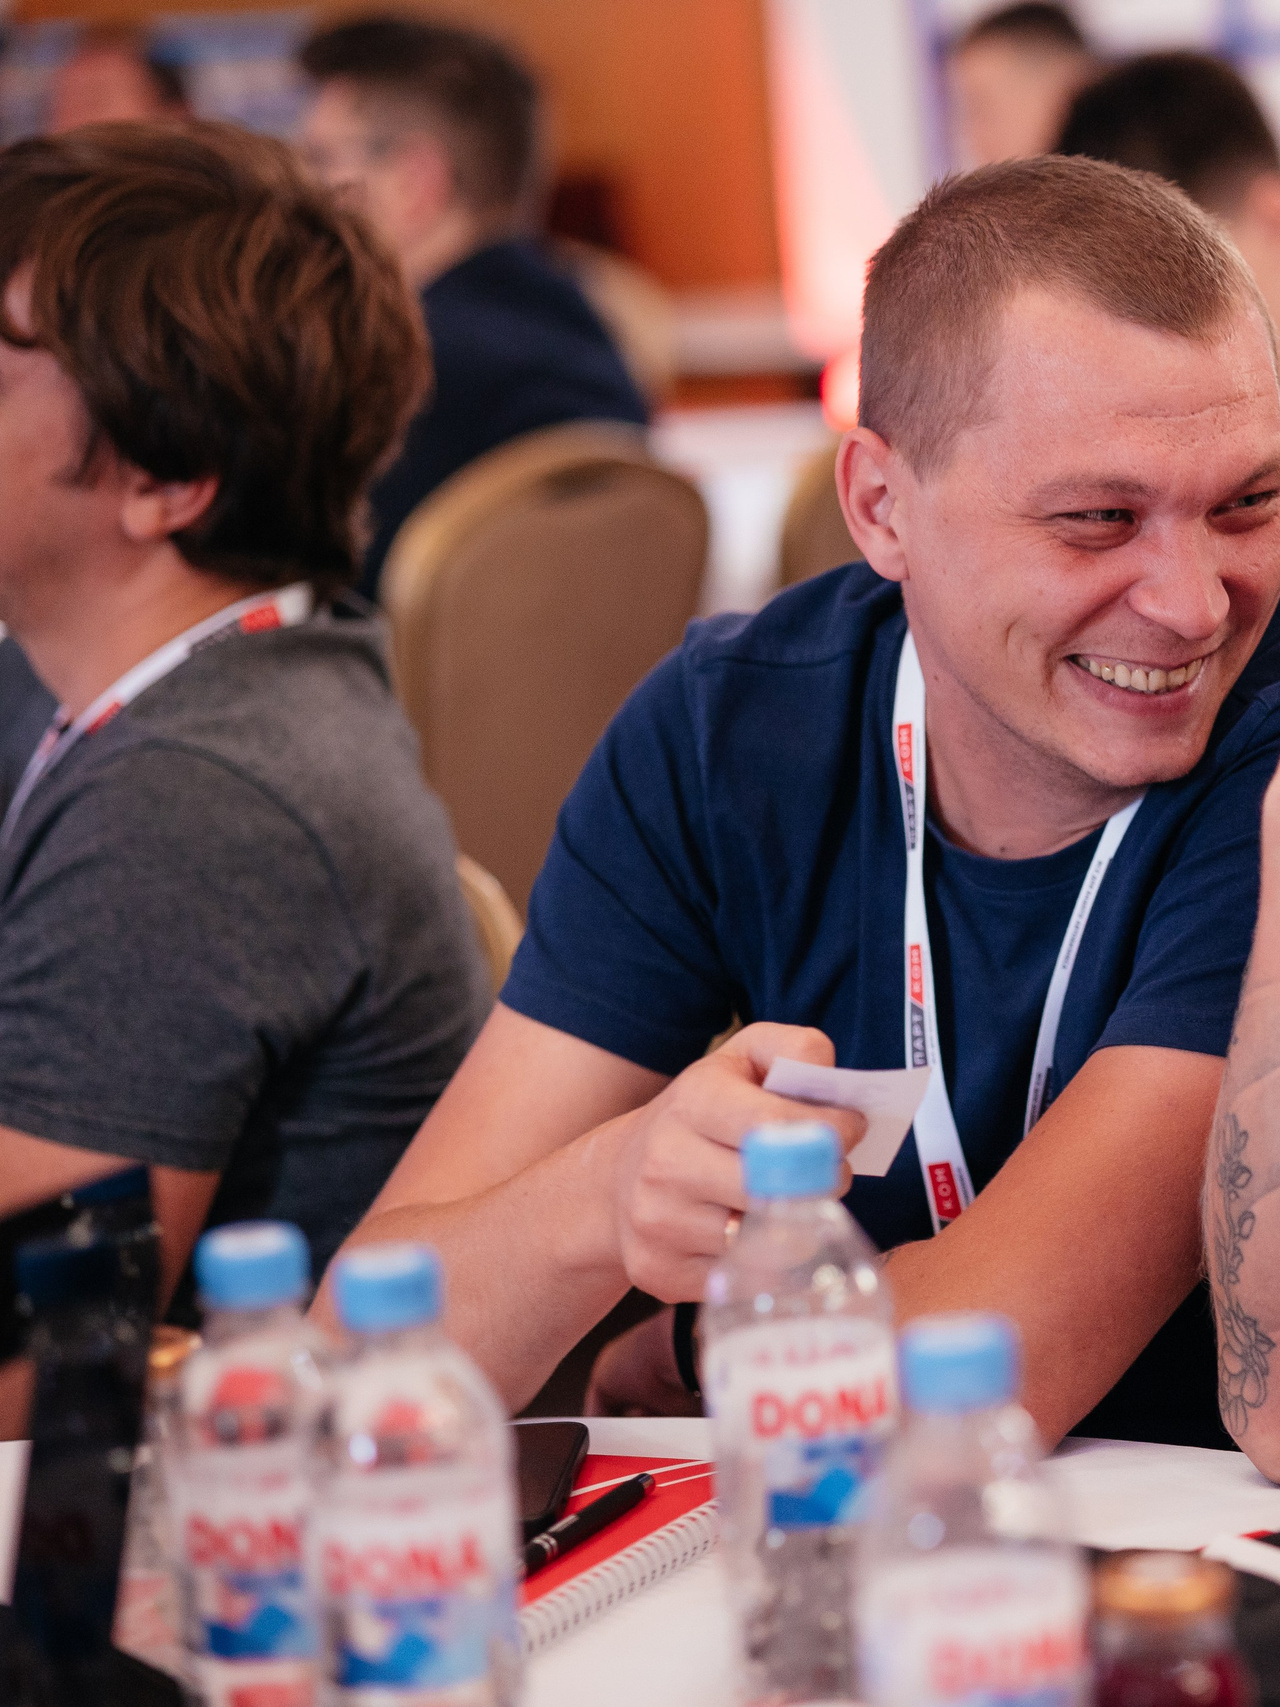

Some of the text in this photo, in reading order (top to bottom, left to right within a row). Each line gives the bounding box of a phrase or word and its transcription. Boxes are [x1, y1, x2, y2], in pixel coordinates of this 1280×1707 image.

[912, 949, 925, 1065] ПАРТ КОМ
[934, 1167, 954, 1210] КОМ
[186, 1515, 300, 1567] DON
